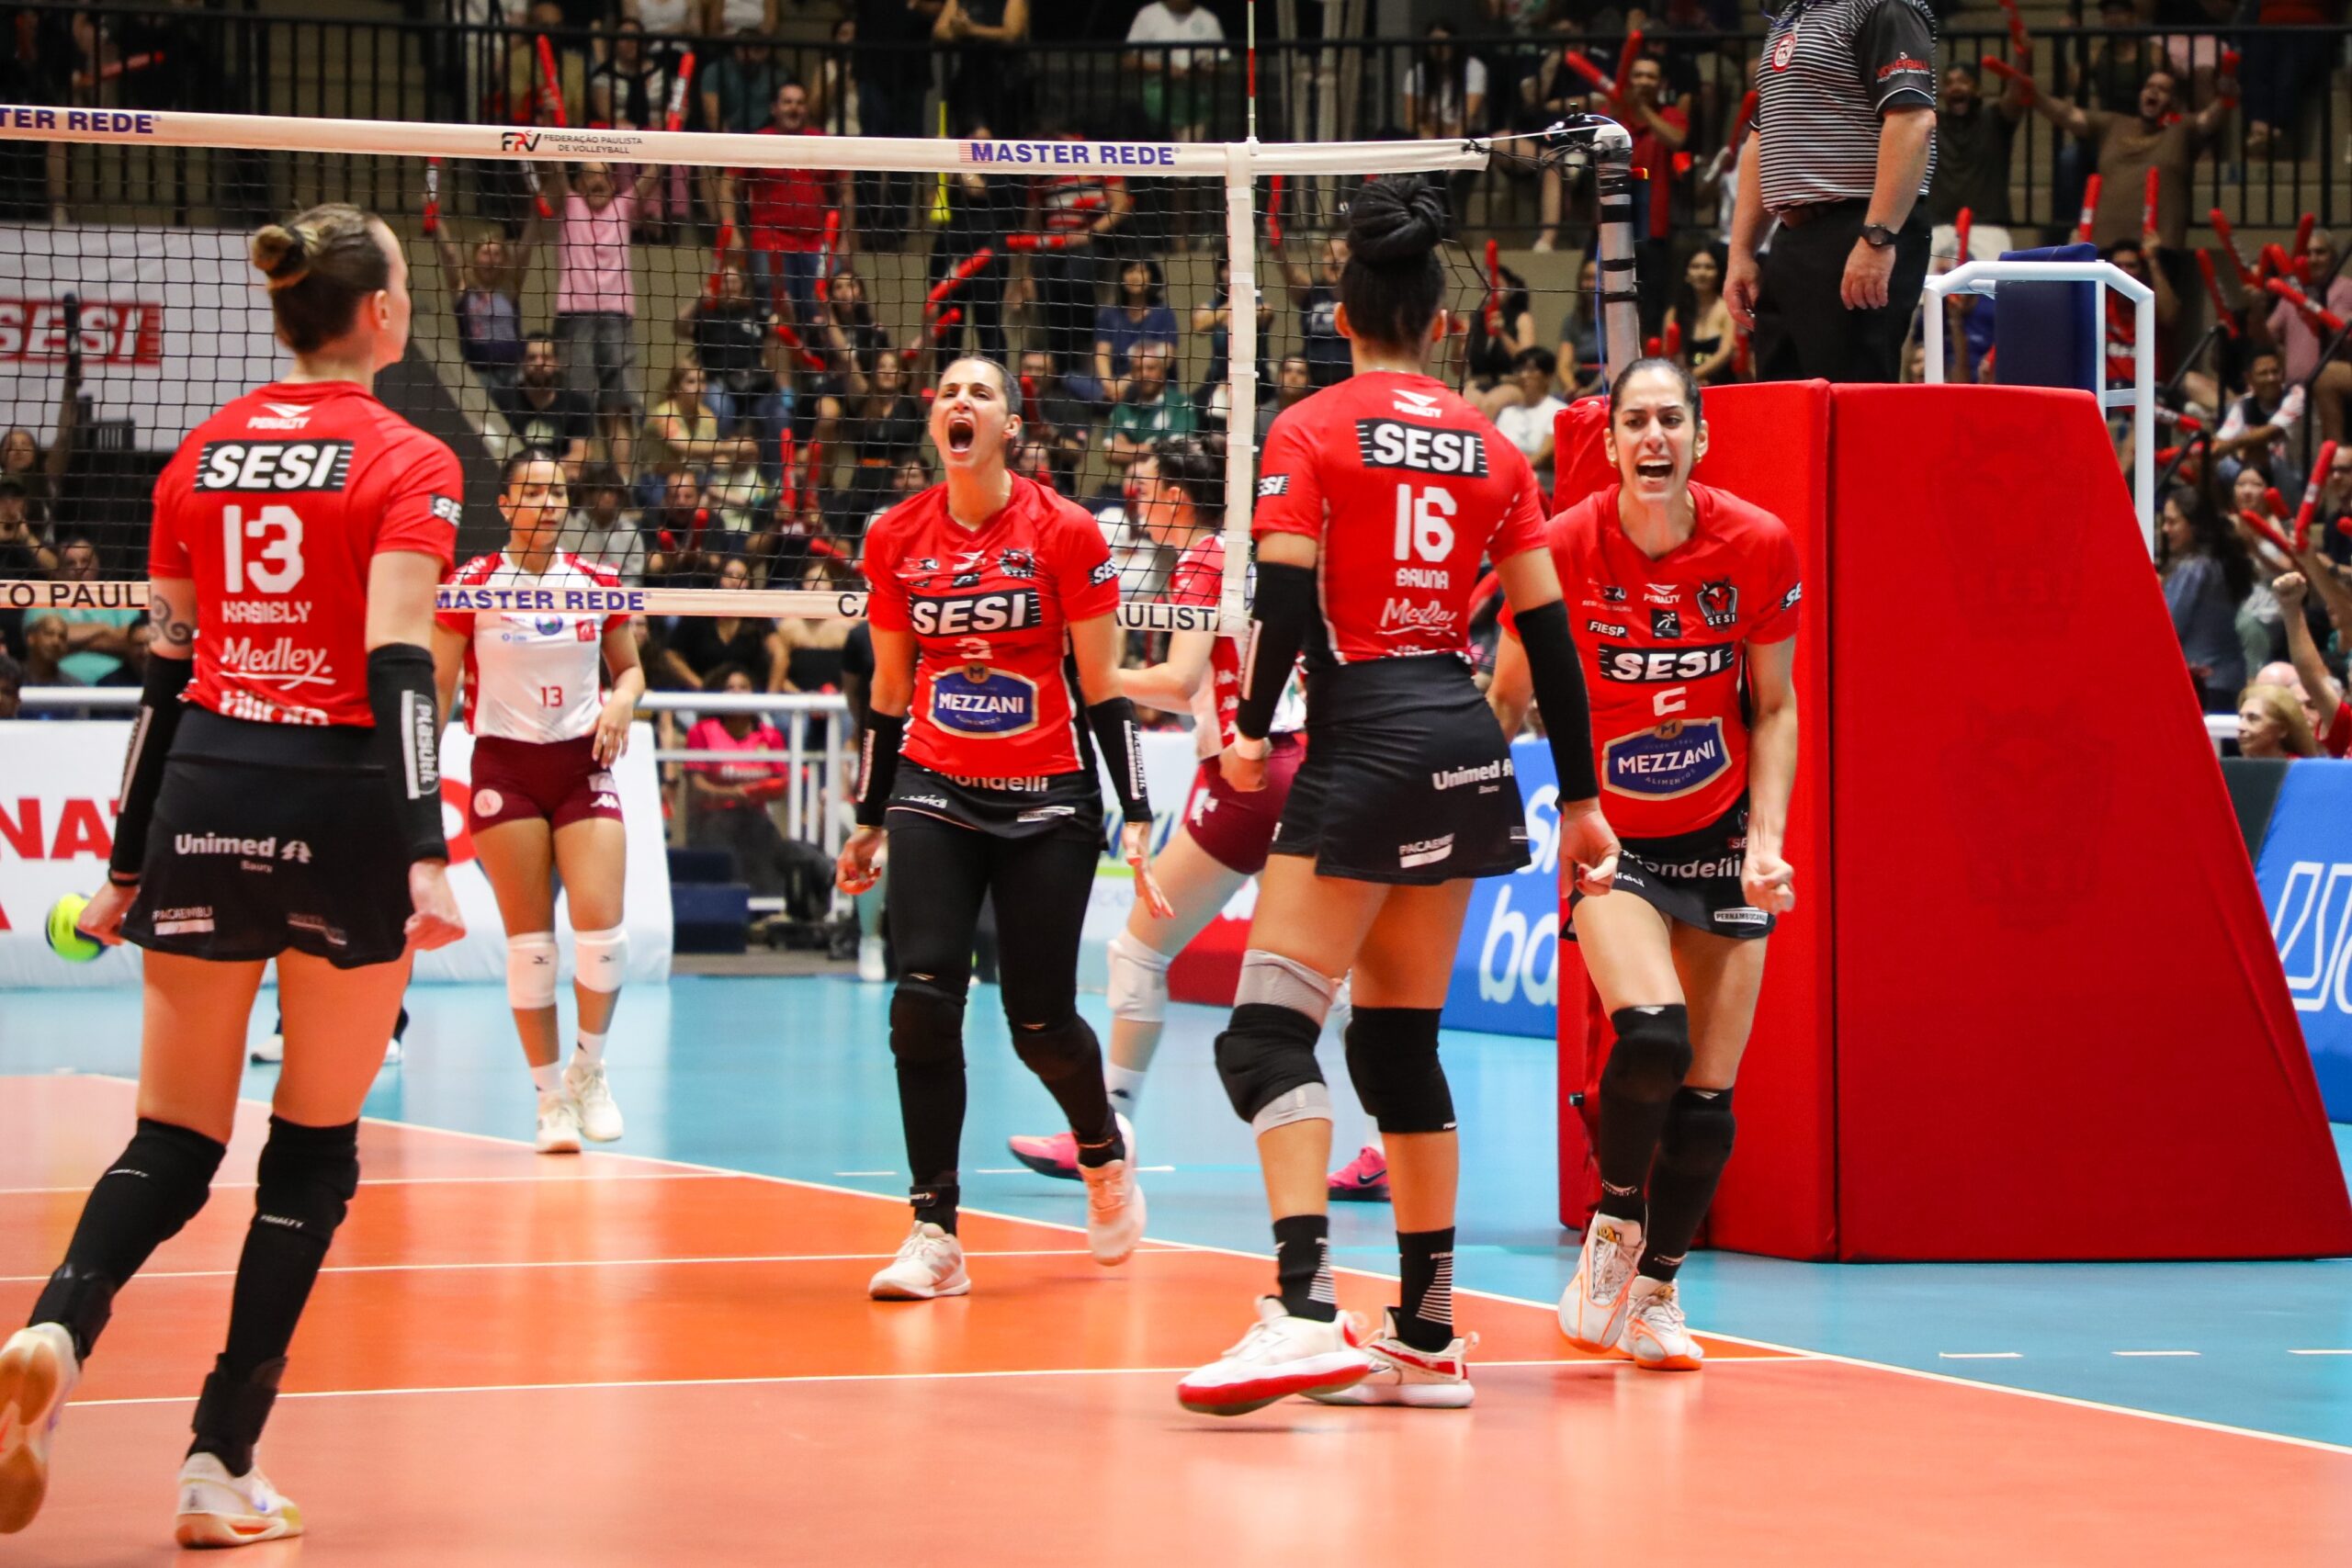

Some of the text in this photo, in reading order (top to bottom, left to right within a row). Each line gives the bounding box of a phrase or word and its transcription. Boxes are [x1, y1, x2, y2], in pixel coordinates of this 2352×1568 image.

[68, 111, 153, 134] REDE
[544, 134, 643, 145] FEDERAÇÃO PAULISTA
[573, 145, 630, 153] VOLLEYBALL
[970, 142, 1175, 165] MASTER REDE
[1373, 423, 1476, 473] SESI
[203, 445, 340, 490] SESI
[1394, 483, 1457, 563] 16
[222, 504, 305, 593] 13
[566, 592, 644, 611] REDE
[1644, 593, 1681, 604] PENALTY
[221, 601, 312, 625] KASIELY
[912, 593, 1026, 635] SESI
[1115, 604, 1219, 632] ULIST
[1706, 614, 1736, 626] SESI
[1589, 621, 1625, 637] FIESP
[1610, 649, 1724, 681] SESI
[540, 686, 563, 707] 13
[938, 693, 1024, 714] MEZZANI
[1618, 739, 1715, 774] MEZZANI
[1432, 760, 1500, 791] Unimed
[0, 798, 119, 860] NA
[175, 832, 277, 858] Unimed
